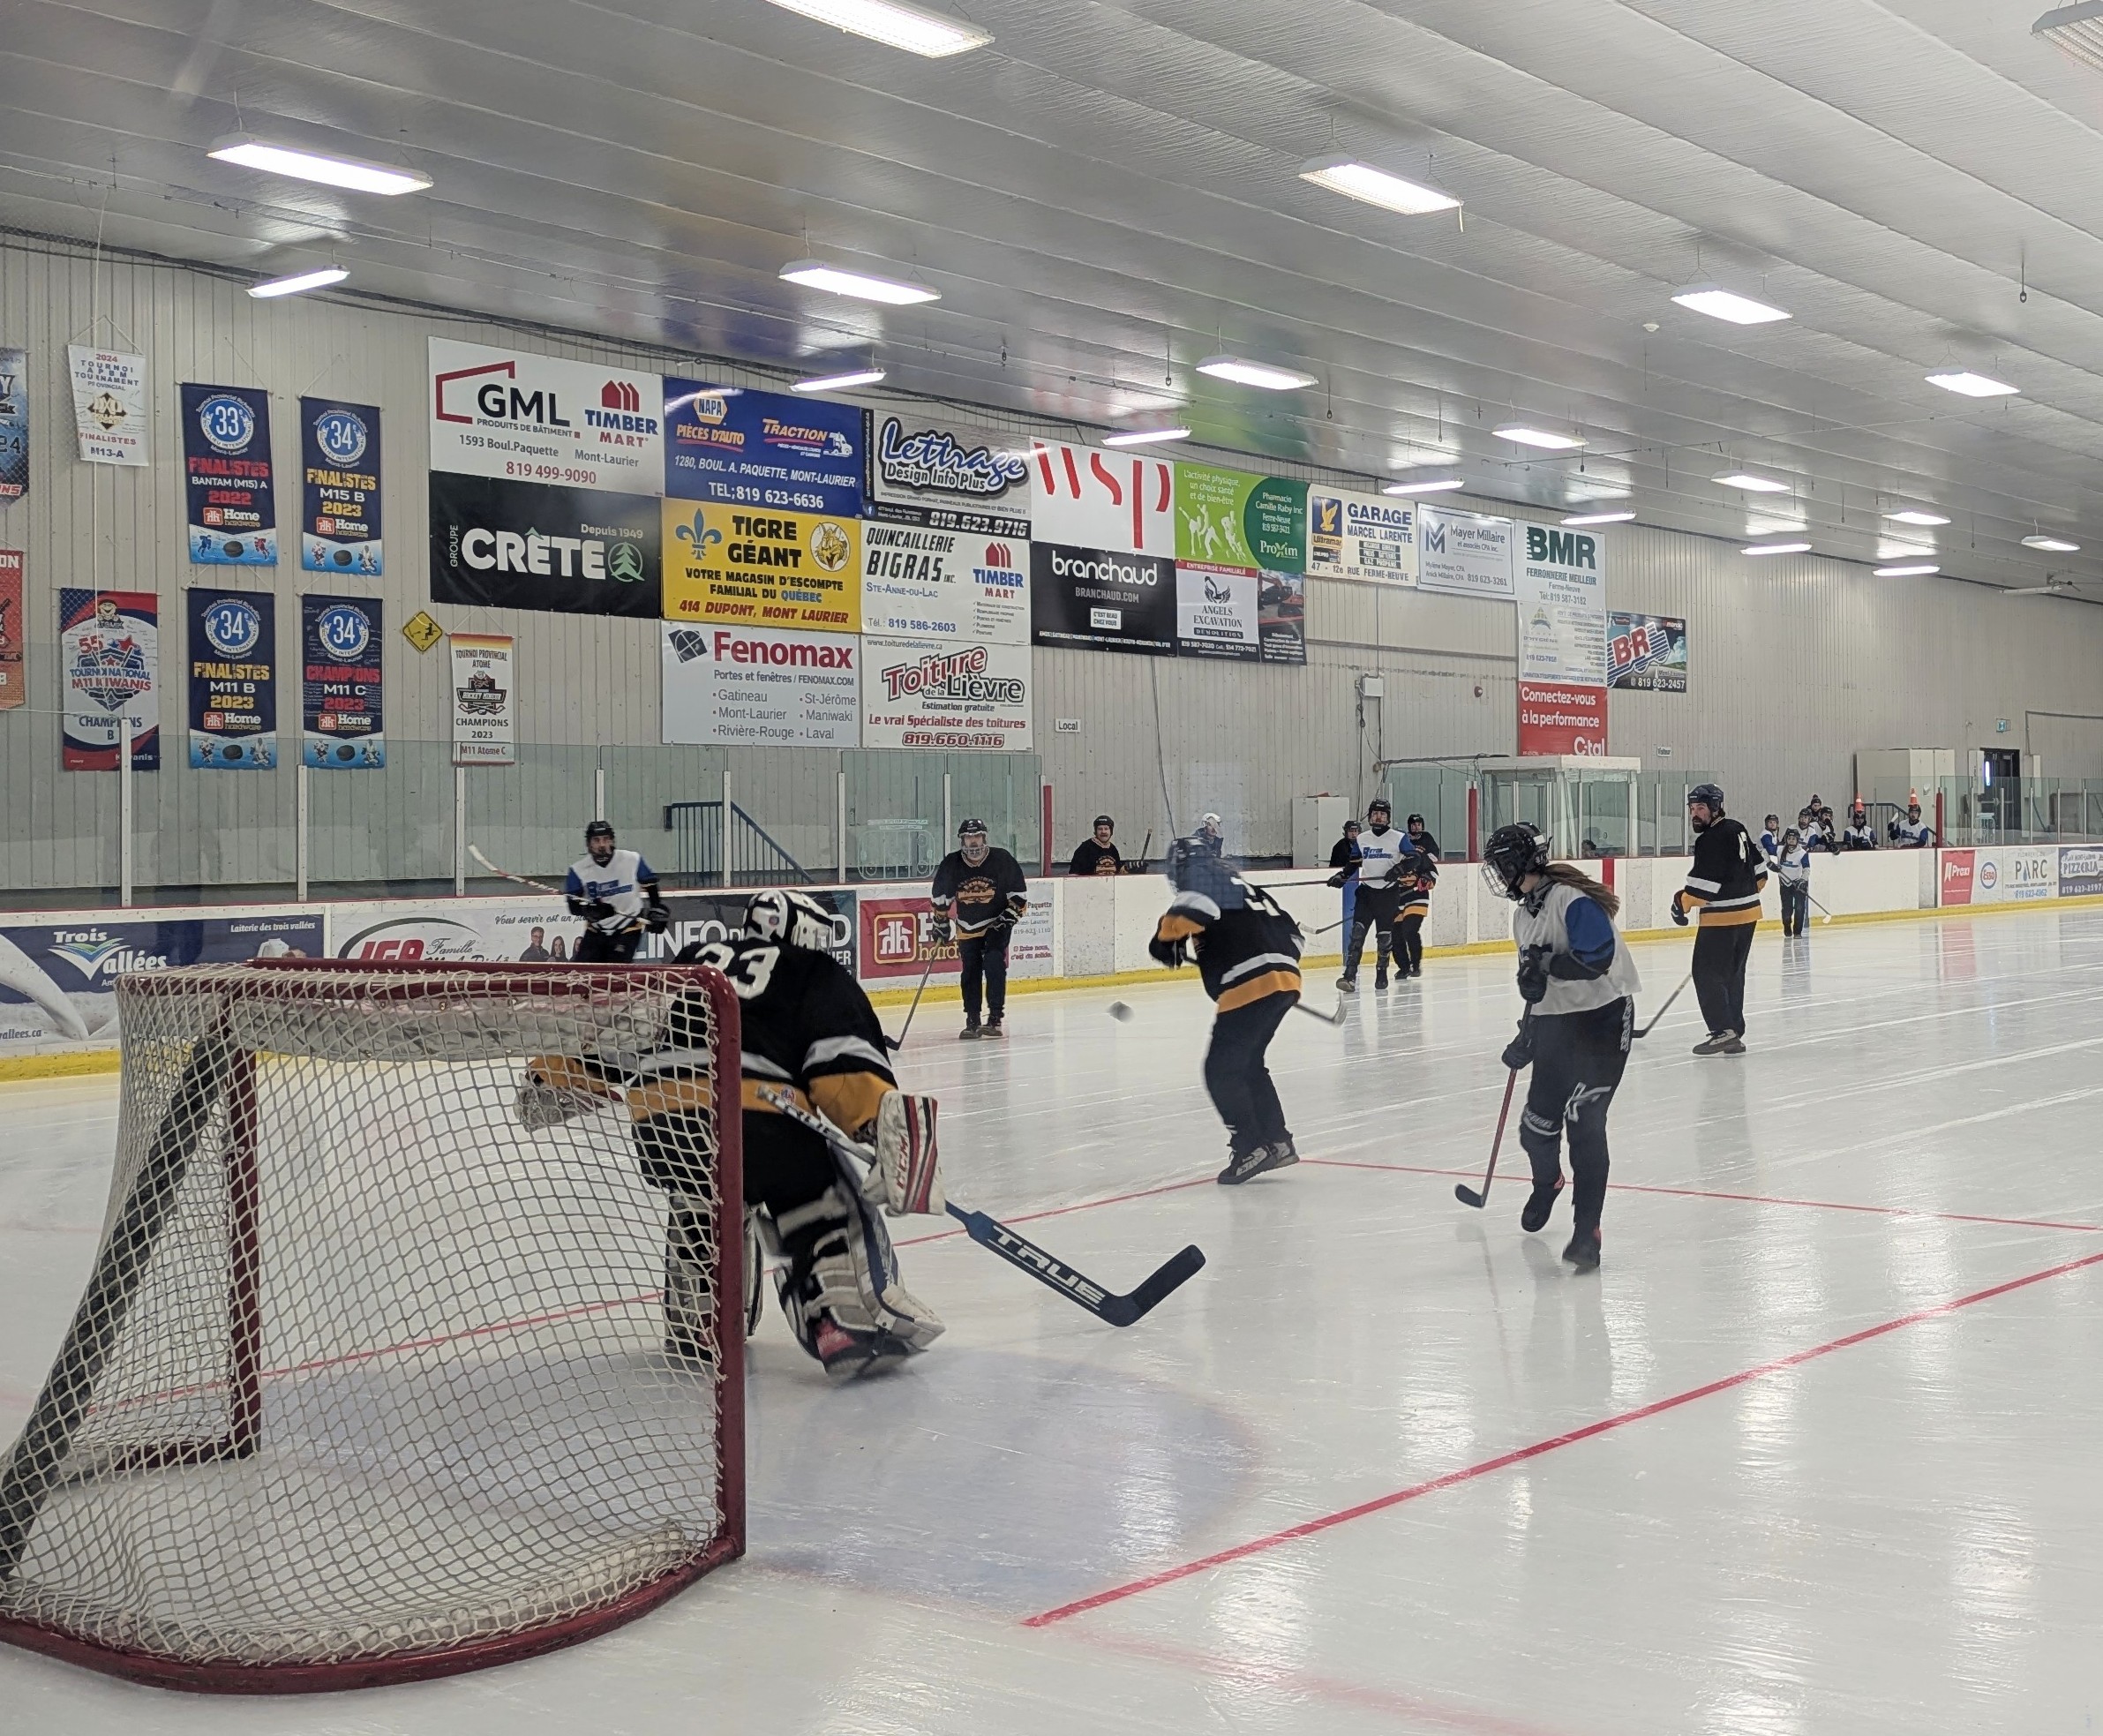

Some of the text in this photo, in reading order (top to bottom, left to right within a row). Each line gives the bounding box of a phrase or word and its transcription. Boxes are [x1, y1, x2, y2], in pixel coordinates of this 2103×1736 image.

[477, 384, 570, 427] GML
[698, 398, 722, 417] NAPA
[477, 418, 573, 439] PRODUITS DE BÂTIMENT
[584, 409, 658, 435] TIMBER
[762, 417, 828, 441] TRACTION
[599, 432, 644, 447] MART
[677, 423, 745, 446] PIÈCES D'AUTO
[460, 435, 639, 467] 1593 Mont-Laurier
[883, 419, 1025, 487] Lettrage
[189, 456, 268, 477] FINALISTES
[506, 462, 597, 485] 819 499-9090
[675, 455, 696, 470] 1280,
[740, 463, 788, 481] PAQUETTE,
[791, 470, 855, 488] MONT-LAURIER
[192, 477, 231, 487] BANTAM
[234, 477, 258, 489] (M15)
[307, 468, 376, 491] FINALISTES
[887, 463, 987, 491] Design Info Plus
[208, 491, 252, 506] 2022
[320, 488, 365, 502] M15 B
[765, 490, 824, 509] 623-6636
[223, 508, 259, 521] Home
[322, 501, 362, 517] 2023
[1348, 503, 1412, 525] GARAGE
[334, 519, 368, 531] Home
[581, 523, 644, 539] Depuis 1949
[732, 515, 797, 541] TIGRE
[1451, 524, 1476, 540] Mayer
[867, 528, 956, 553] QUINCAILLERIE
[1348, 524, 1413, 544] MARCEL LARENTE
[450, 524, 459, 567] GROUPE
[462, 527, 606, 580] CRÊTE
[727, 539, 802, 568] GÉANT
[1527, 526, 1596, 569] BMR
[867, 551, 944, 582] BIGRAS
[1052, 550, 1158, 586] branchaud
[1311, 562, 1320, 571] 47
[686, 567, 844, 591] VOTRE MAGASIN D'ESCOMPTE
[973, 568, 1024, 588] TIMBER
[1468, 574, 1478, 582] 819
[710, 584, 822, 603] FAMILIAL DU QUÉBEC
[985, 587, 1015, 599] MART
[1075, 587, 1139, 603] BRANCHAUD.COM
[680, 599, 849, 624] 414 DUPONT, MONT LAURIER
[1202, 605, 1233, 616] ANGELS
[889, 619, 957, 633] 819 586-2603
[1193, 615, 1243, 628] EXCAVATION
[714, 631, 853, 669] Fenomax
[194, 661, 269, 680] FINALISTES
[306, 665, 380, 683] CHAMPIONS
[714, 670, 854, 686] Portes et fenêtres FENOMAX.COM
[883, 647, 987, 700] Toiture
[210, 681, 256, 694] M11 B
[324, 684, 367, 695] M11 C
[925, 673, 1024, 700] de la Lièvre
[1638, 677, 1686, 688] 819 623-2457
[210, 695, 254, 709] 2023
[324, 697, 364, 710] 2023
[718, 689, 768, 703] Gatineau
[805, 693, 857, 706] St-Jérôme
[1521, 687, 1596, 706] Connectez-vous
[718, 707, 787, 720] Mont-Laurier
[922, 702, 995, 713] Estimation gratuite
[224, 712, 261, 724] Home
[337, 714, 372, 725] Home
[455, 718, 508, 727] CHAMPIONS
[806, 710, 853, 722] Maniwaki
[869, 714, 1026, 729] Le vrai Spécialiste des toitures
[1522, 710, 1600, 727] à la performance
[718, 725, 795, 740] Rivière-Rouge
[806, 727, 834, 740] Laval
[1059, 720, 1078, 731] Local
[107, 730, 114, 740] B
[2062, 861, 2099, 875] PIZZERIA
[230, 921, 316, 933] Laiterie des trois vallées
[494, 914, 515, 926] Vous
[517, 913, 544, 925] servir
[545, 914, 560, 923] est
[53, 928, 107, 943] Trois
[359, 939, 425, 960] IGA
[425, 936, 476, 956] Famille
[993, 1224, 1107, 1306] TRUE
